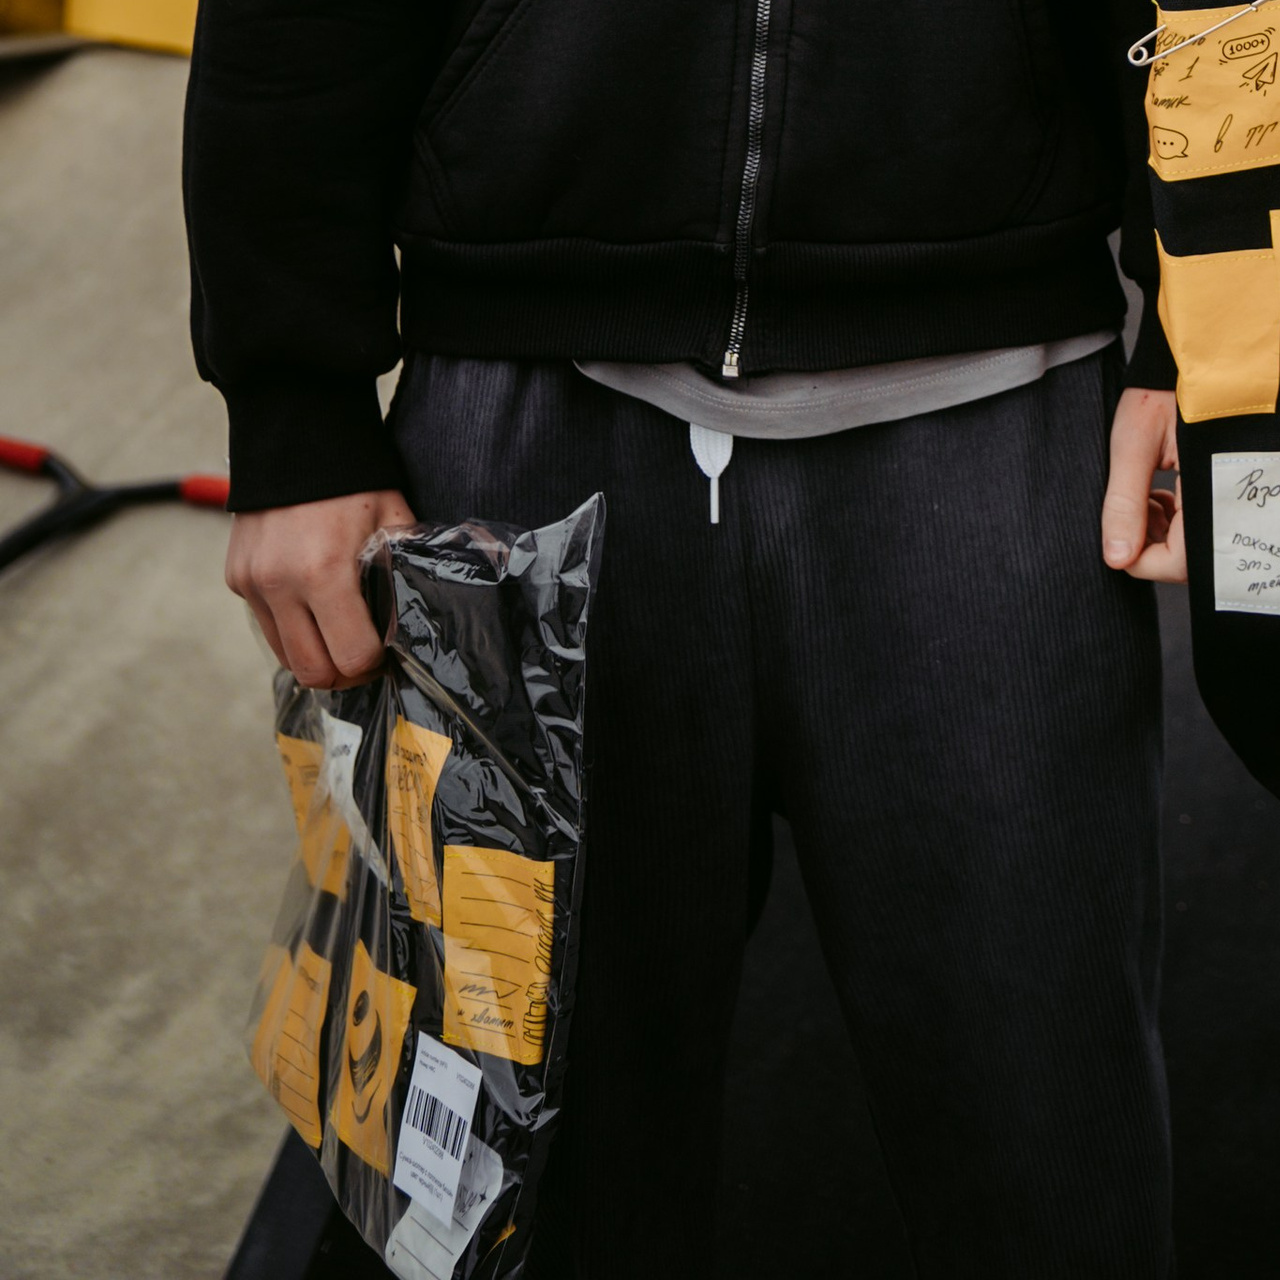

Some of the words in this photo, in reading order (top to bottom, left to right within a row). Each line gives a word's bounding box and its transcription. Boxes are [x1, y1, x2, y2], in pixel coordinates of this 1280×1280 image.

[1229, 39, 1266, 55] 1000+
[1178, 56, 1200, 82] 1
[1236, 558, 1272, 572] это
